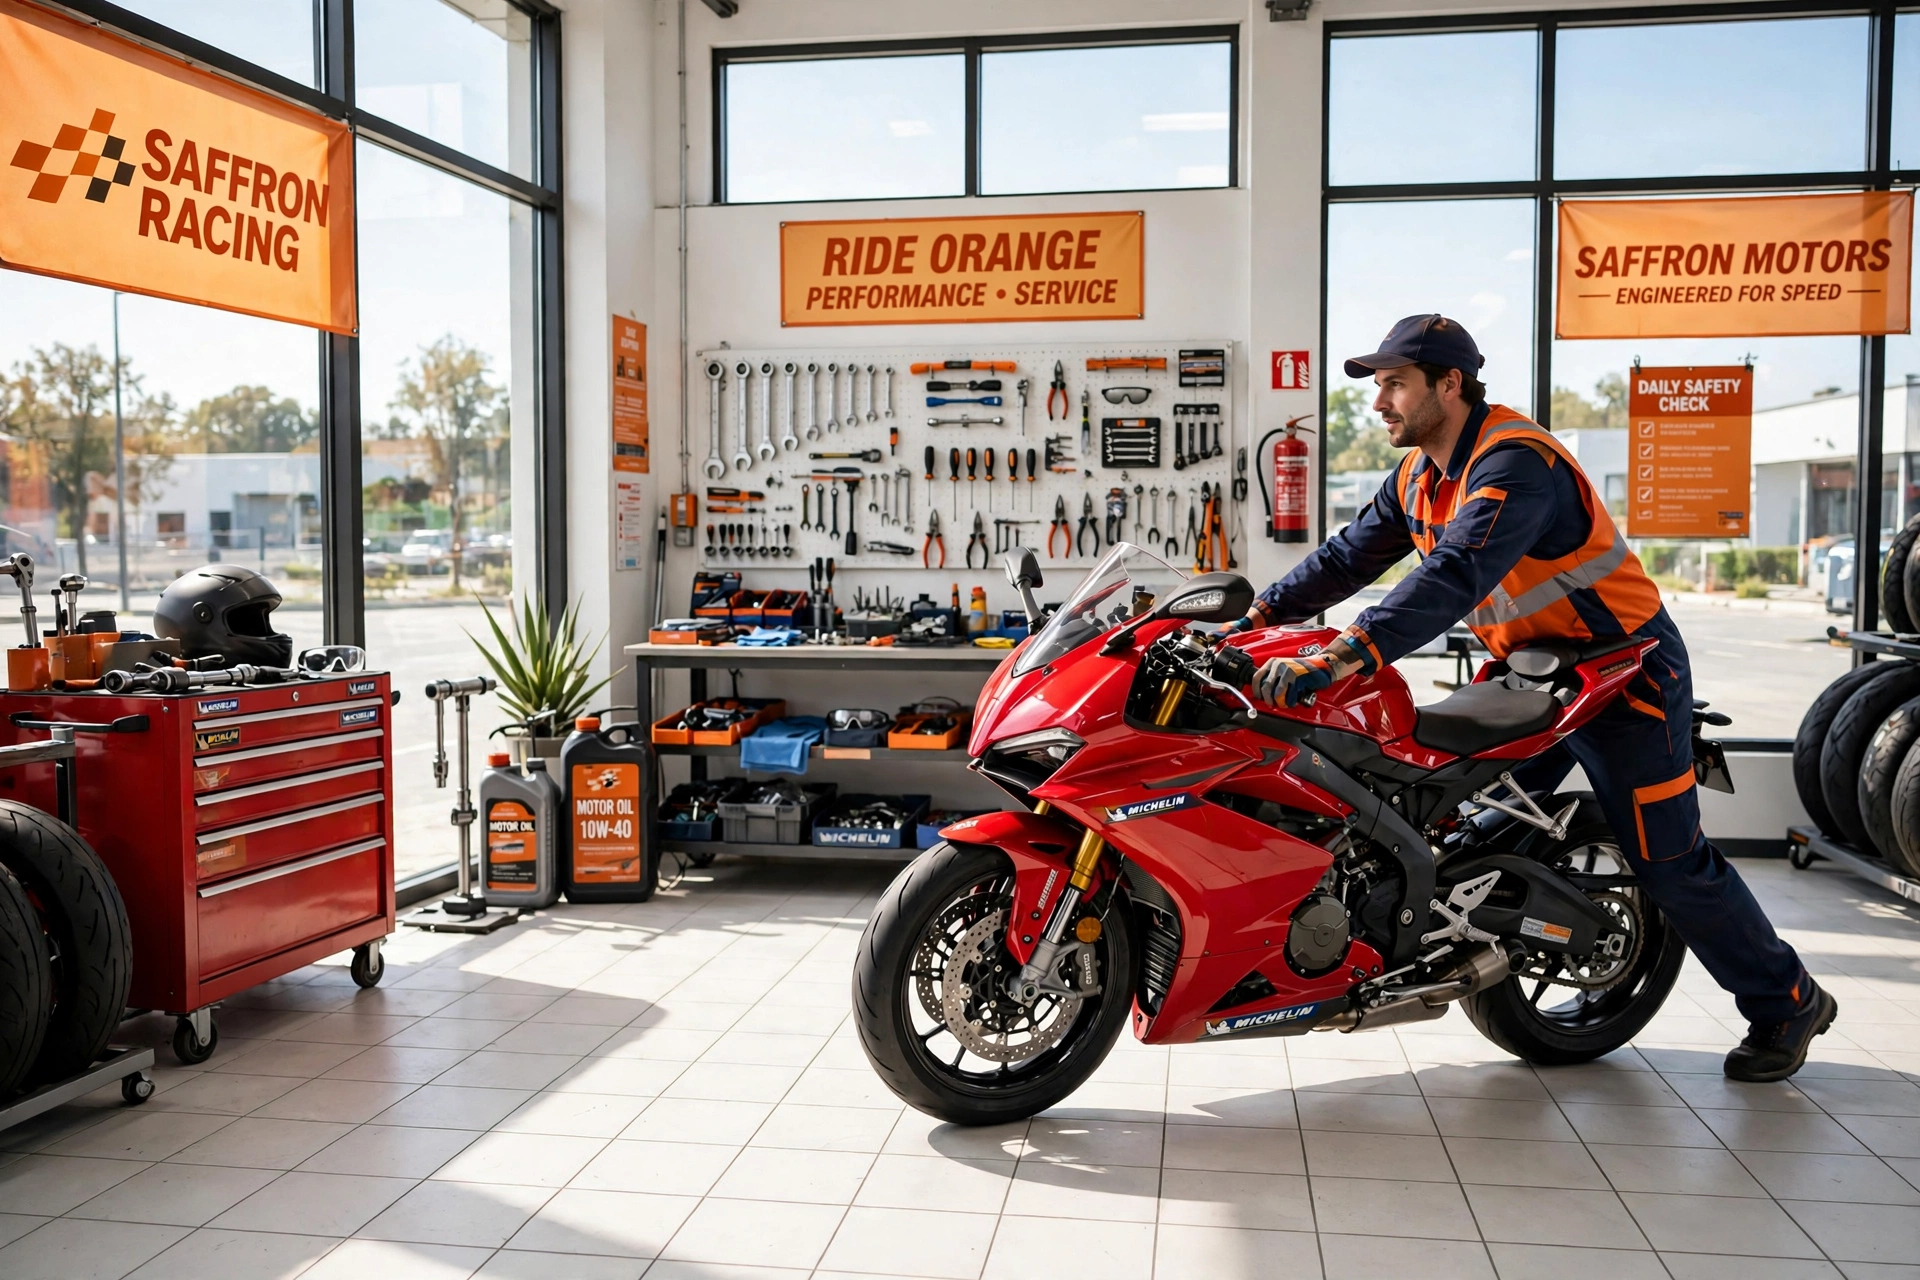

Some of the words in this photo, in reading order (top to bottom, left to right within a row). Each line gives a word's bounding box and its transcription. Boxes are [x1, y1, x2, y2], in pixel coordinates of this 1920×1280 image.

[142, 128, 330, 228] SAFFRON
[138, 186, 300, 273] RACING
[822, 235, 919, 276] RIDE
[929, 230, 1102, 274] ORANGE
[1574, 243, 1735, 279] SAFFRON
[1743, 238, 1893, 275] MOTORS
[806, 283, 988, 310] PERFORMANCE
[1014, 279, 1119, 305] SERVICE
[1615, 285, 1733, 304] ENGINEERED
[1738, 284, 1776, 302] FOR
[1781, 283, 1842, 301] SPEED
[1638, 379, 1681, 394] DAILY
[1684, 378, 1742, 394] SAFETY
[1658, 396, 1710, 412] CHECK
[576, 799, 615, 815] MOTOR
[616, 798, 634, 815] OIL
[1127, 795, 1186, 816] MICHELIN
[489, 821, 519, 832] MOTOR
[520, 821, 535, 832] OIL
[580, 819, 632, 839] 10W-40
[1233, 1005, 1315, 1029] MICHELIN
